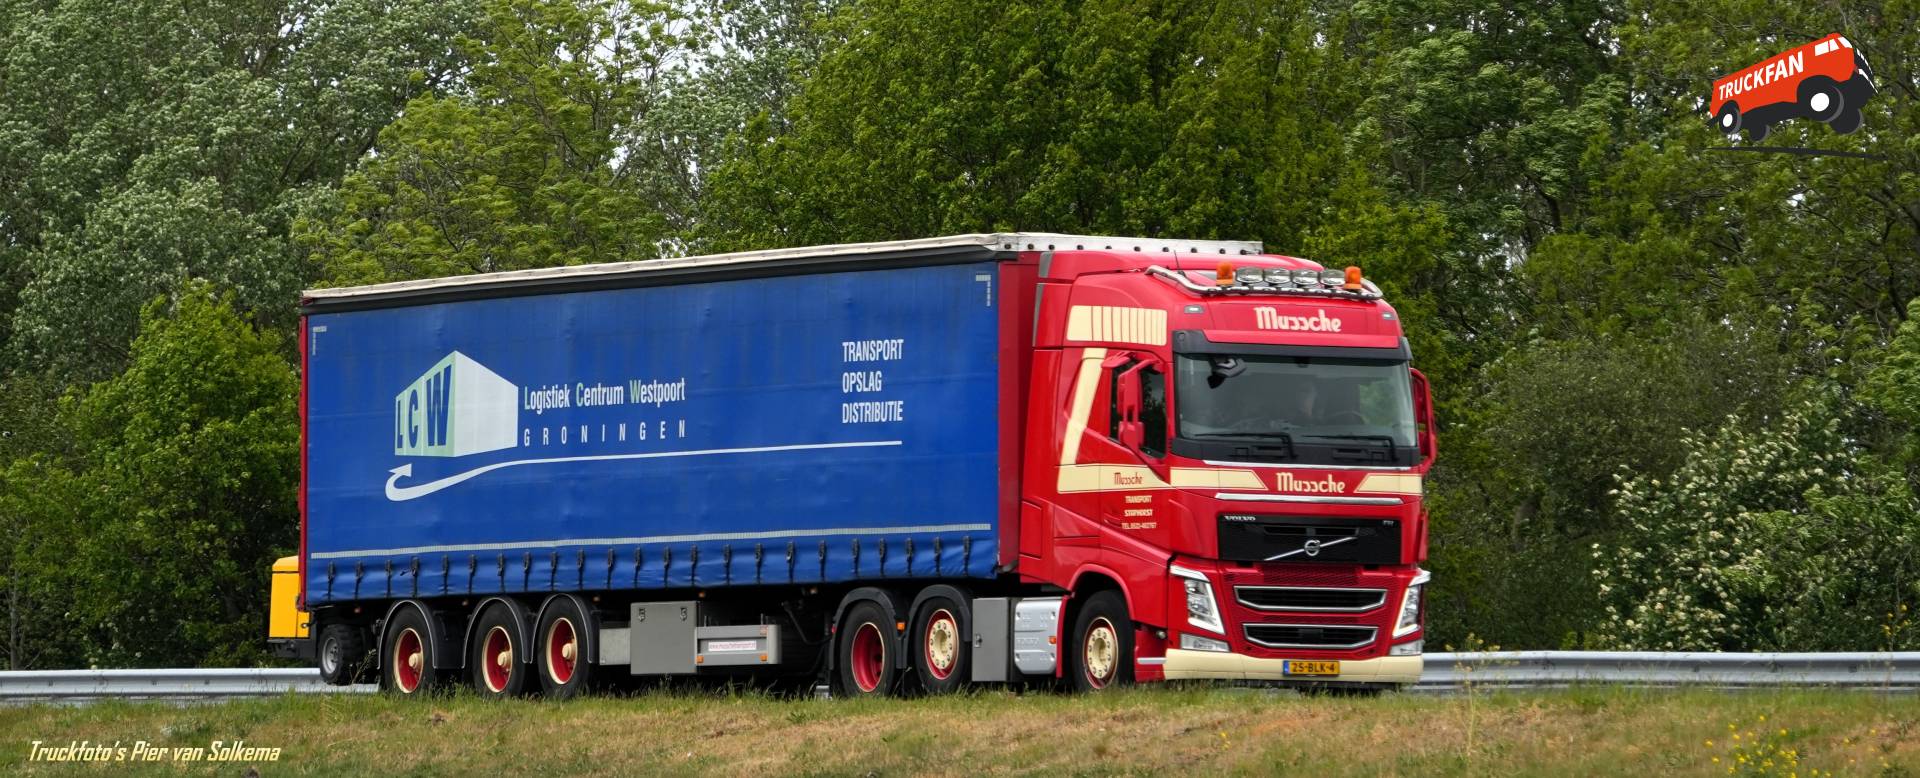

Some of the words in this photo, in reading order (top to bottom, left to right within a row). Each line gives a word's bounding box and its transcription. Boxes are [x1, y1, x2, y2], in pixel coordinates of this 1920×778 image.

[1254, 306, 1342, 332] Mussche
[842, 339, 904, 362] TRANSPORT
[842, 371, 882, 393] OPSLAG
[397, 364, 452, 449] LCW
[524, 384, 571, 415] Logistiek
[576, 382, 625, 407] Centrum
[629, 377, 686, 408] Westpoort
[842, 400, 904, 423] DISTRIBUTIE
[524, 419, 686, 447] GRONINGEN
[1114, 472, 1143, 485] Mussche
[1276, 472, 1346, 493] Mussche
[1125, 495, 1153, 503] TRANSPORT
[1290, 662, 1336, 673] 25-BLK-4
